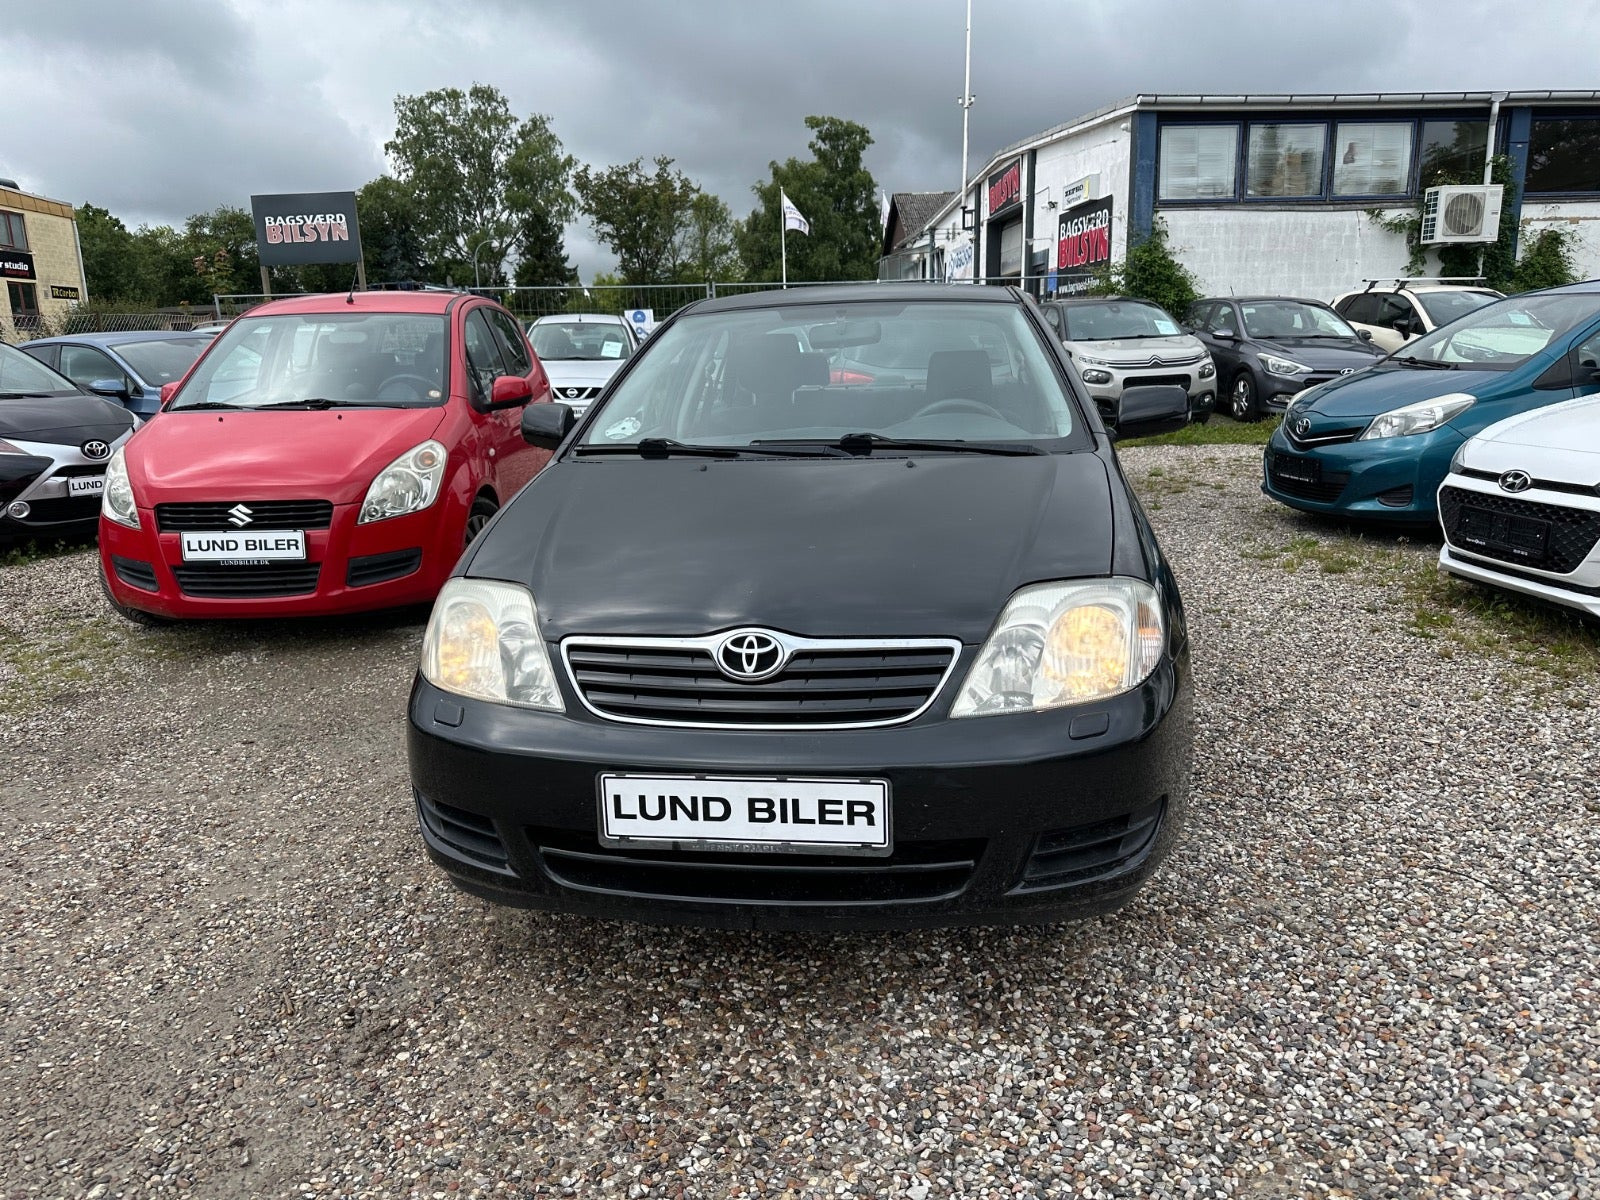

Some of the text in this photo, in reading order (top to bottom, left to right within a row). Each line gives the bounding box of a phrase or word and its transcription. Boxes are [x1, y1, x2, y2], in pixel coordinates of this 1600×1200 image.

[990, 163, 1019, 213] BILSYN
[265, 213, 346, 226] BAGSVÆRD
[266, 221, 349, 244] BILSYN
[1059, 223, 1109, 270] BILSYN
[4, 261, 29, 271] studio
[71, 480, 103, 491] LUND
[186, 538, 300, 552] LUND BILER
[613, 794, 876, 827] LUND BILER
